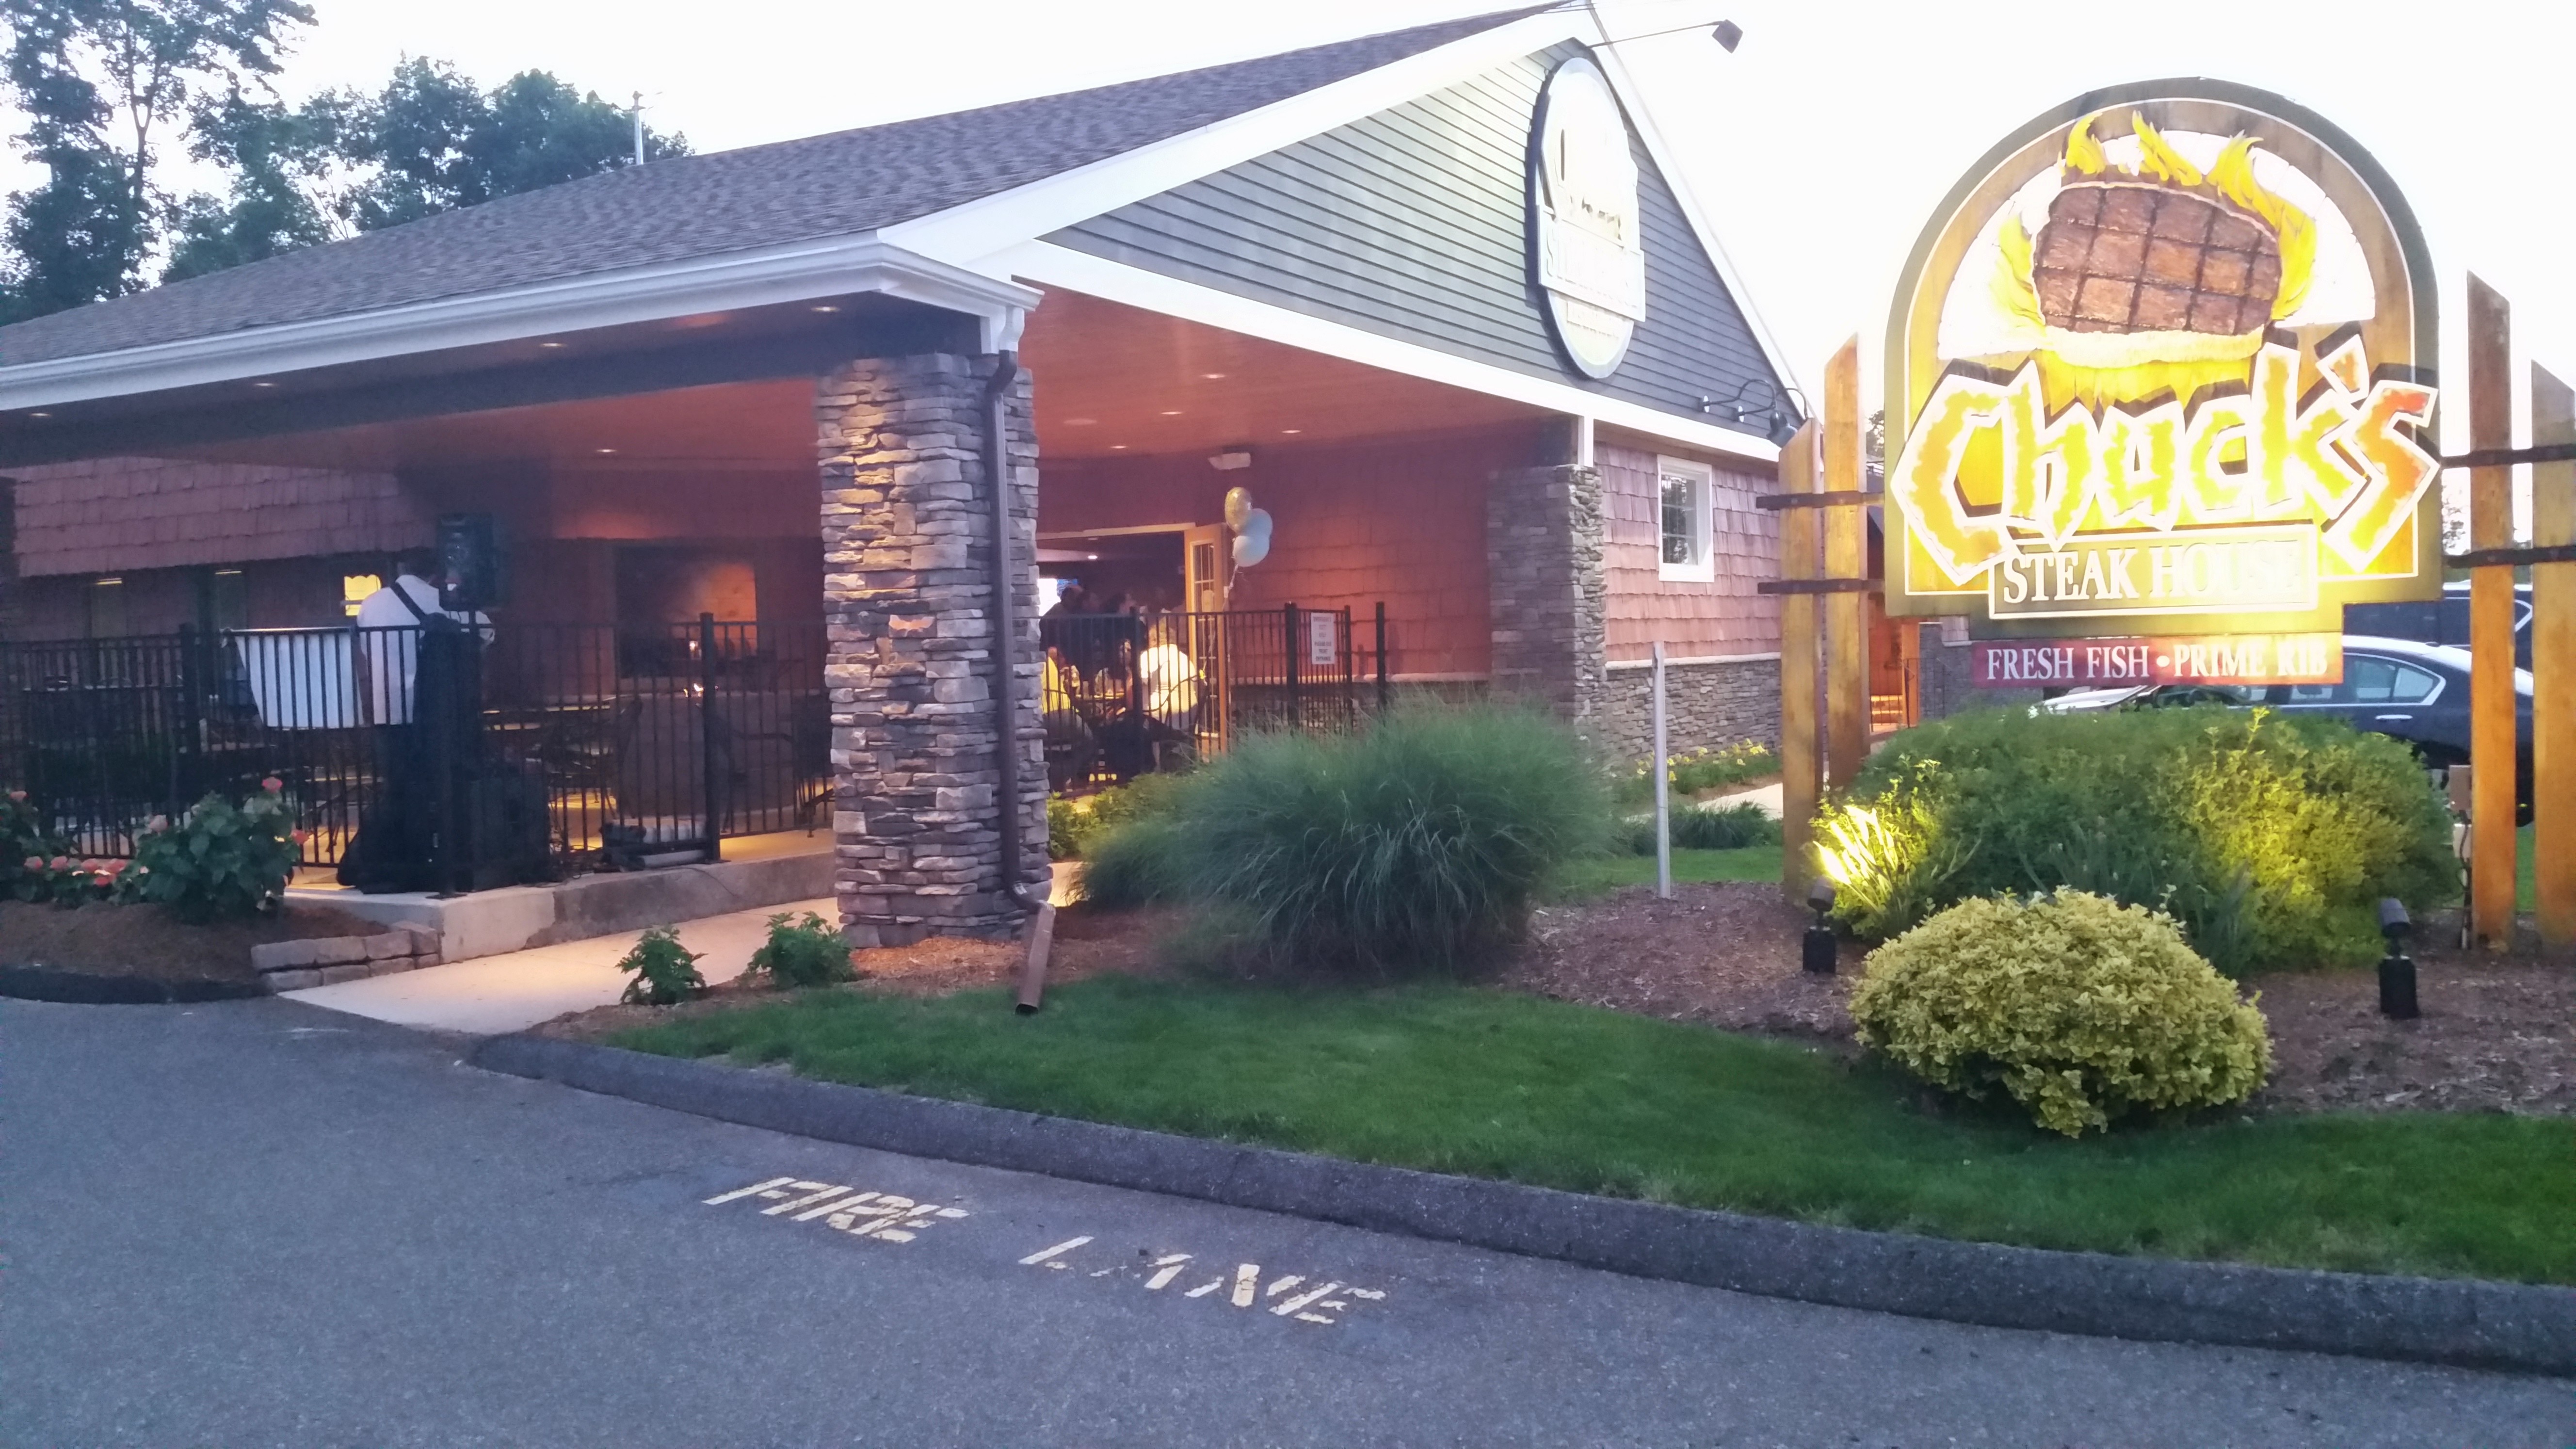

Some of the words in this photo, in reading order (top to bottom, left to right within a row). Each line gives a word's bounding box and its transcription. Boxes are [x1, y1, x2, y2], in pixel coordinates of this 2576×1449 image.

[1890, 342, 2439, 586] Chuck's
[2003, 549, 2140, 604] STEAK
[2149, 539, 2300, 599] HOUSE
[1987, 647, 2074, 679] FRESH
[2086, 645, 2150, 678] FISH
[2277, 641, 2327, 676] RIB
[701, 1176, 970, 1243] FIRE
